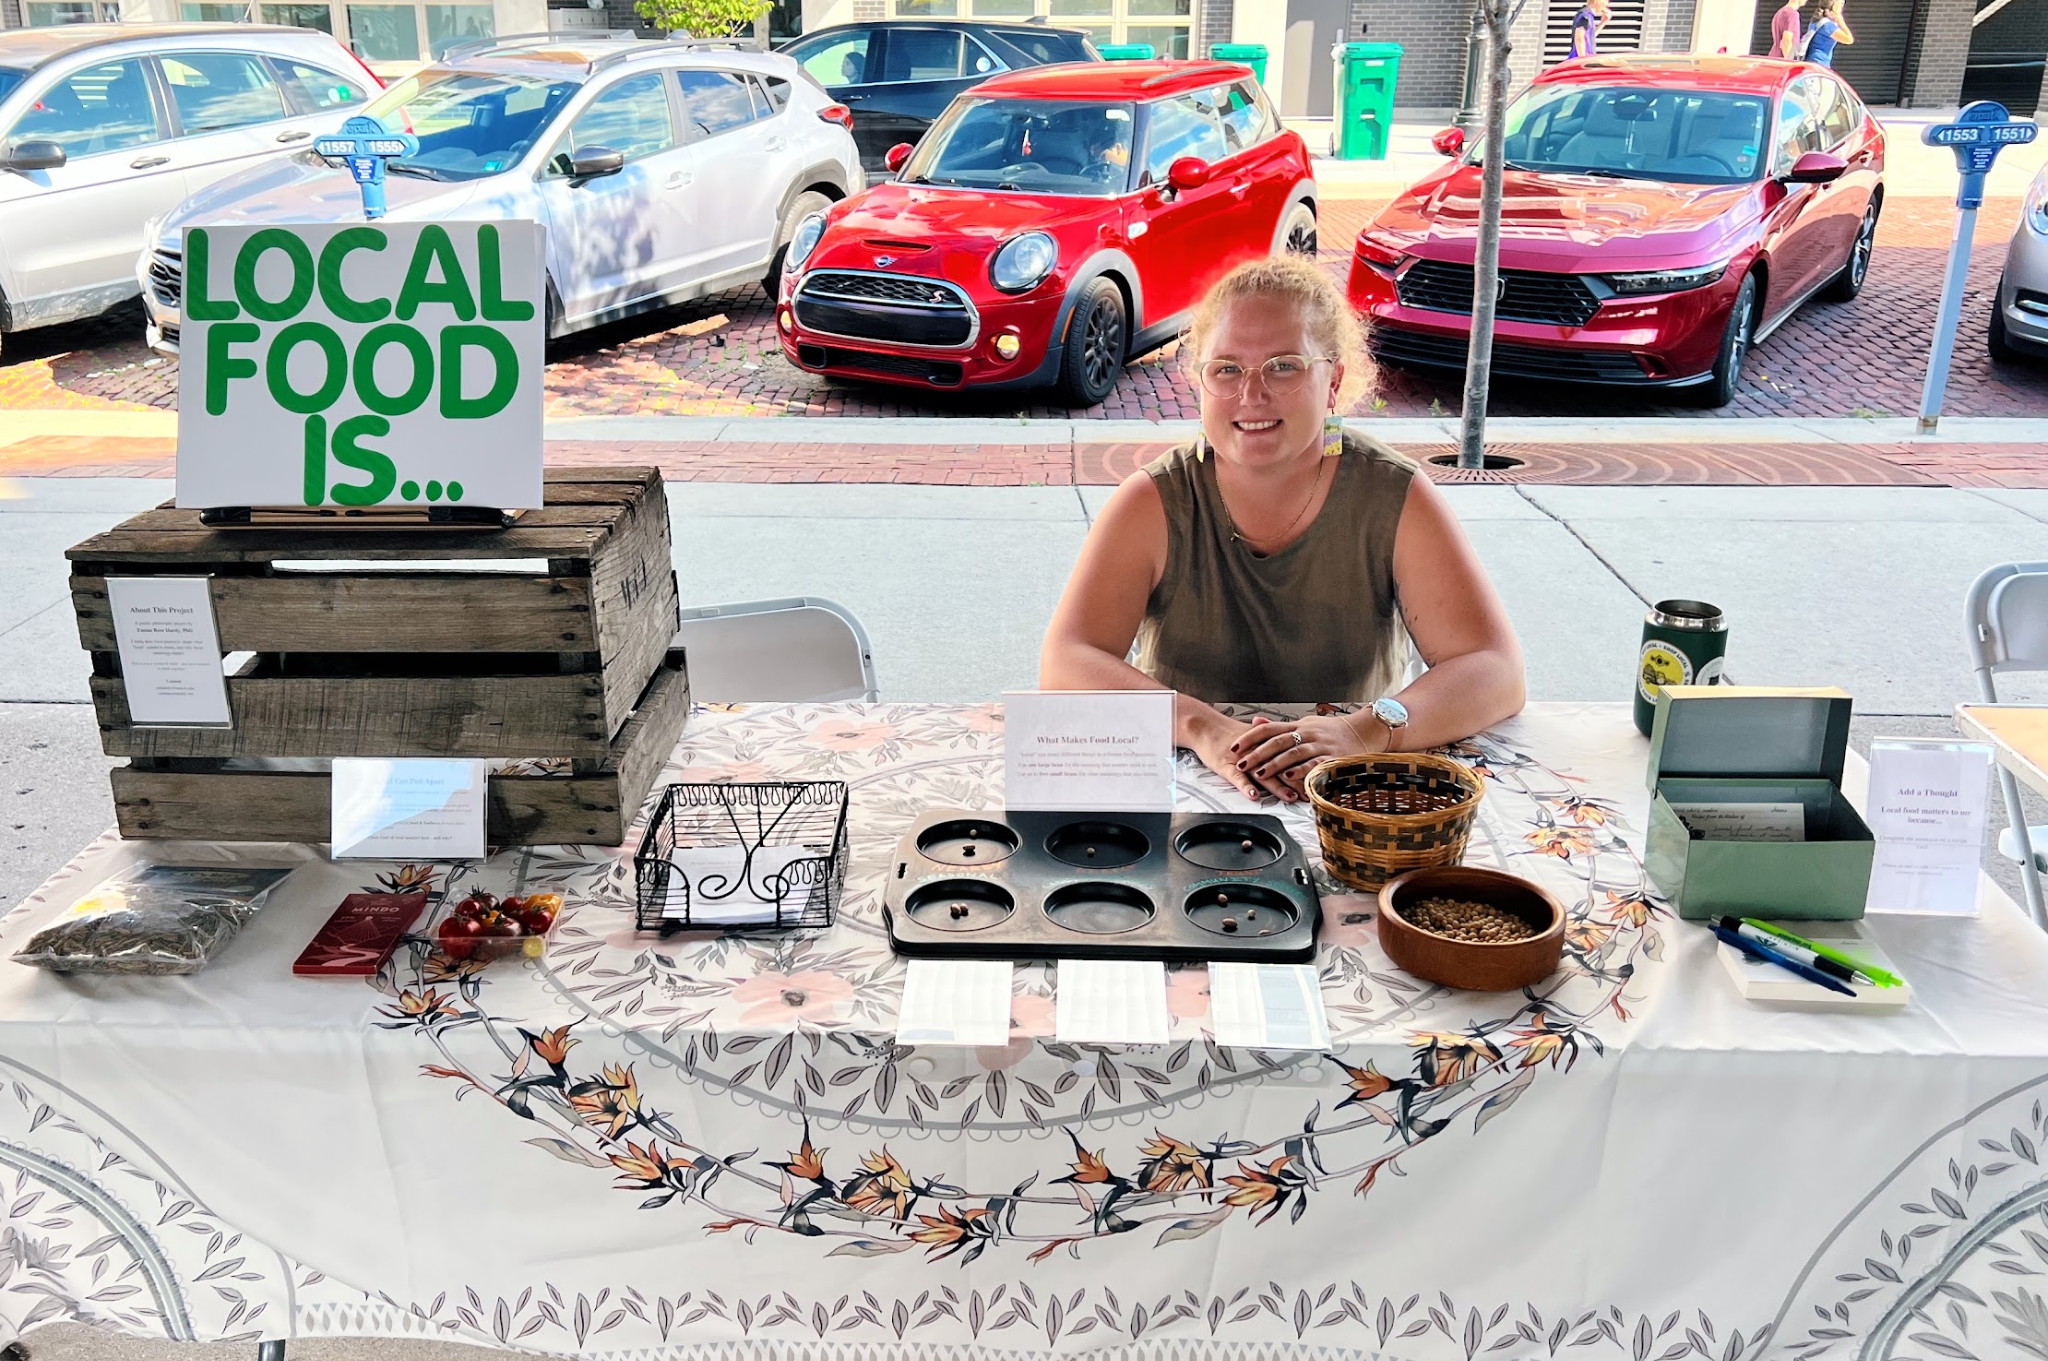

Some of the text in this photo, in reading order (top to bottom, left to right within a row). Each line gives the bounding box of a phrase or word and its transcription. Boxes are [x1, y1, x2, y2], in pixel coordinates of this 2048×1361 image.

[1945, 128, 1978, 141] 1553
[1994, 128, 2025, 140] 1551
[327, 141, 355, 153] 1557
[369, 141, 399, 153] 1555
[187, 223, 534, 322] LOCAL
[206, 322, 519, 419] FOOD
[303, 414, 464, 507] IS...
[130, 606, 194, 615] About This Project
[1037, 736, 1139, 744] What Makes Food Local?
[1898, 788, 1914, 796] Add
[1924, 789, 1958, 798] Thought
[917, 872, 999, 883] SEASONAL
[1183, 876, 1261, 892] COMMUNITY
[351, 906, 400, 914] MINDO
